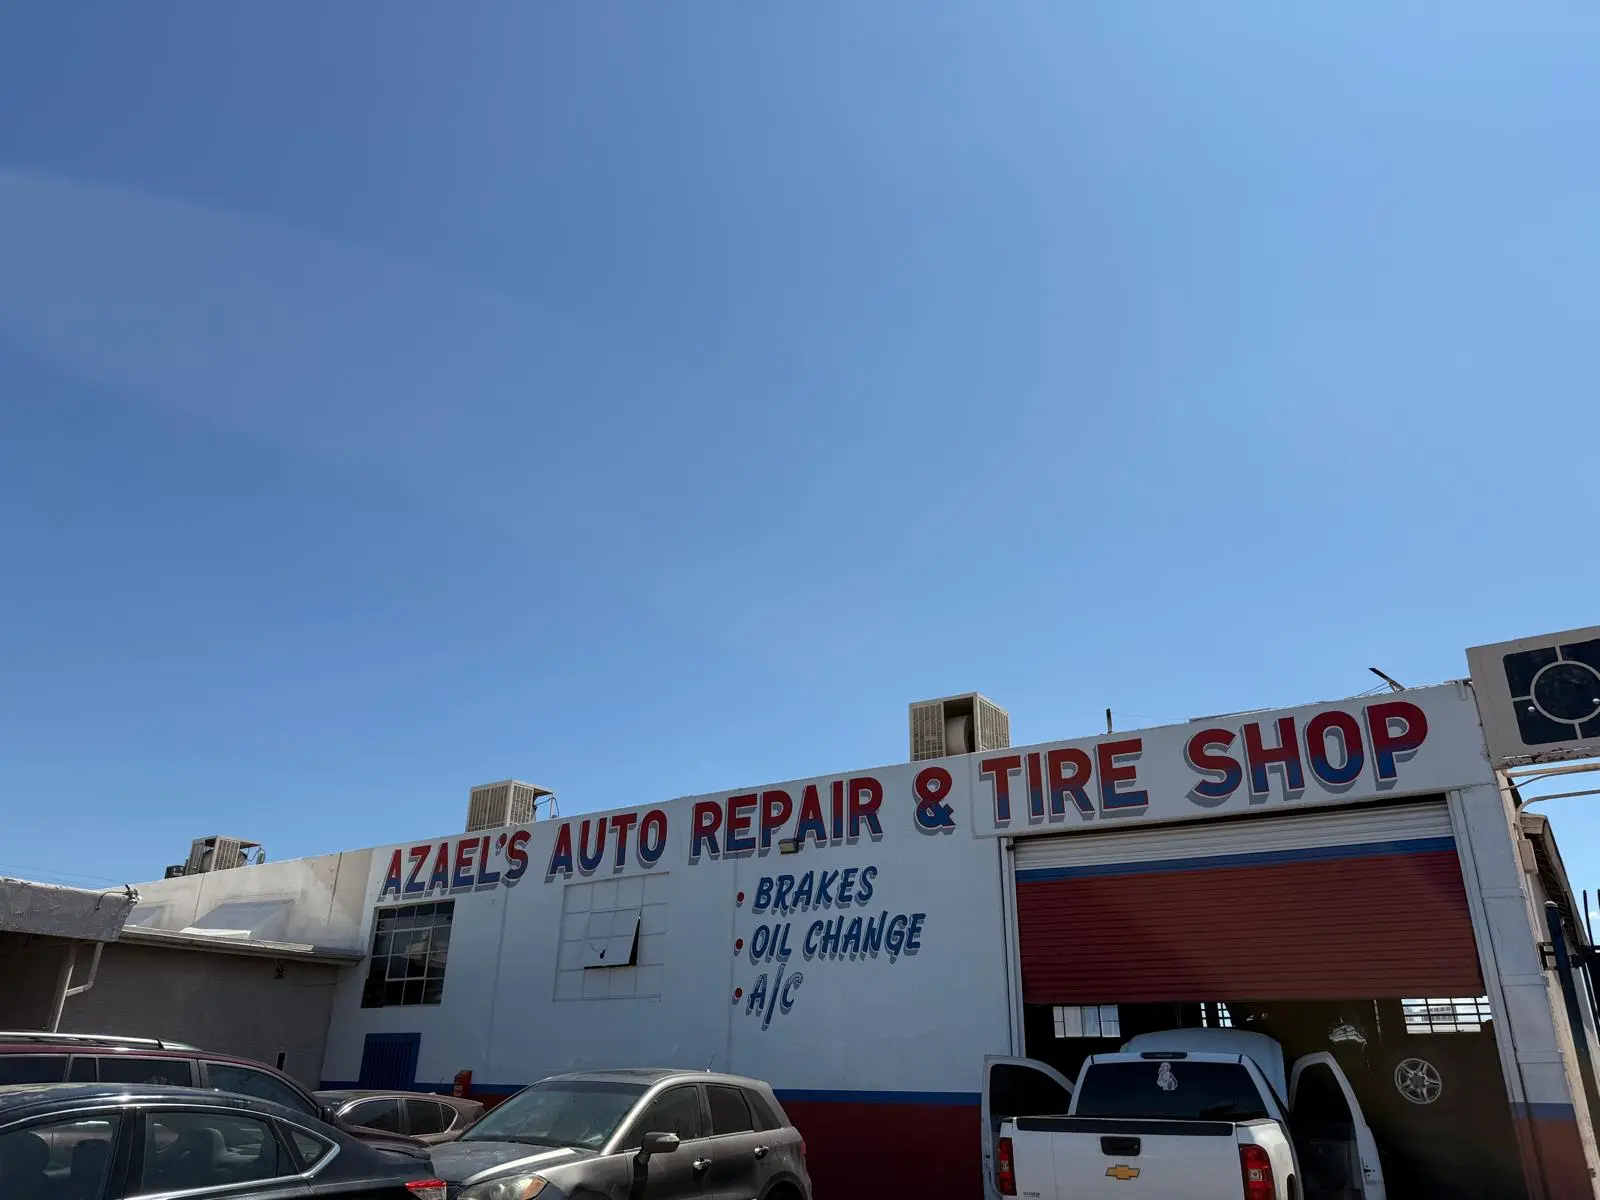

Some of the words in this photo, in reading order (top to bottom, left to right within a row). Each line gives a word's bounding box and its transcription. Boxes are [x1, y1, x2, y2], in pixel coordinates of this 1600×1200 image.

[380, 829, 531, 897] AZAEL'S
[548, 808, 668, 877] AUTO
[690, 776, 884, 859] REPAIR
[913, 766, 956, 831] &
[980, 737, 1150, 822] TIRE
[1186, 700, 1429, 801] SHOP
[753, 865, 878, 912] BRAKES
[750, 922, 792, 961] OIL
[803, 910, 926, 957] CHANGE
[747, 963, 804, 1027] A/C
